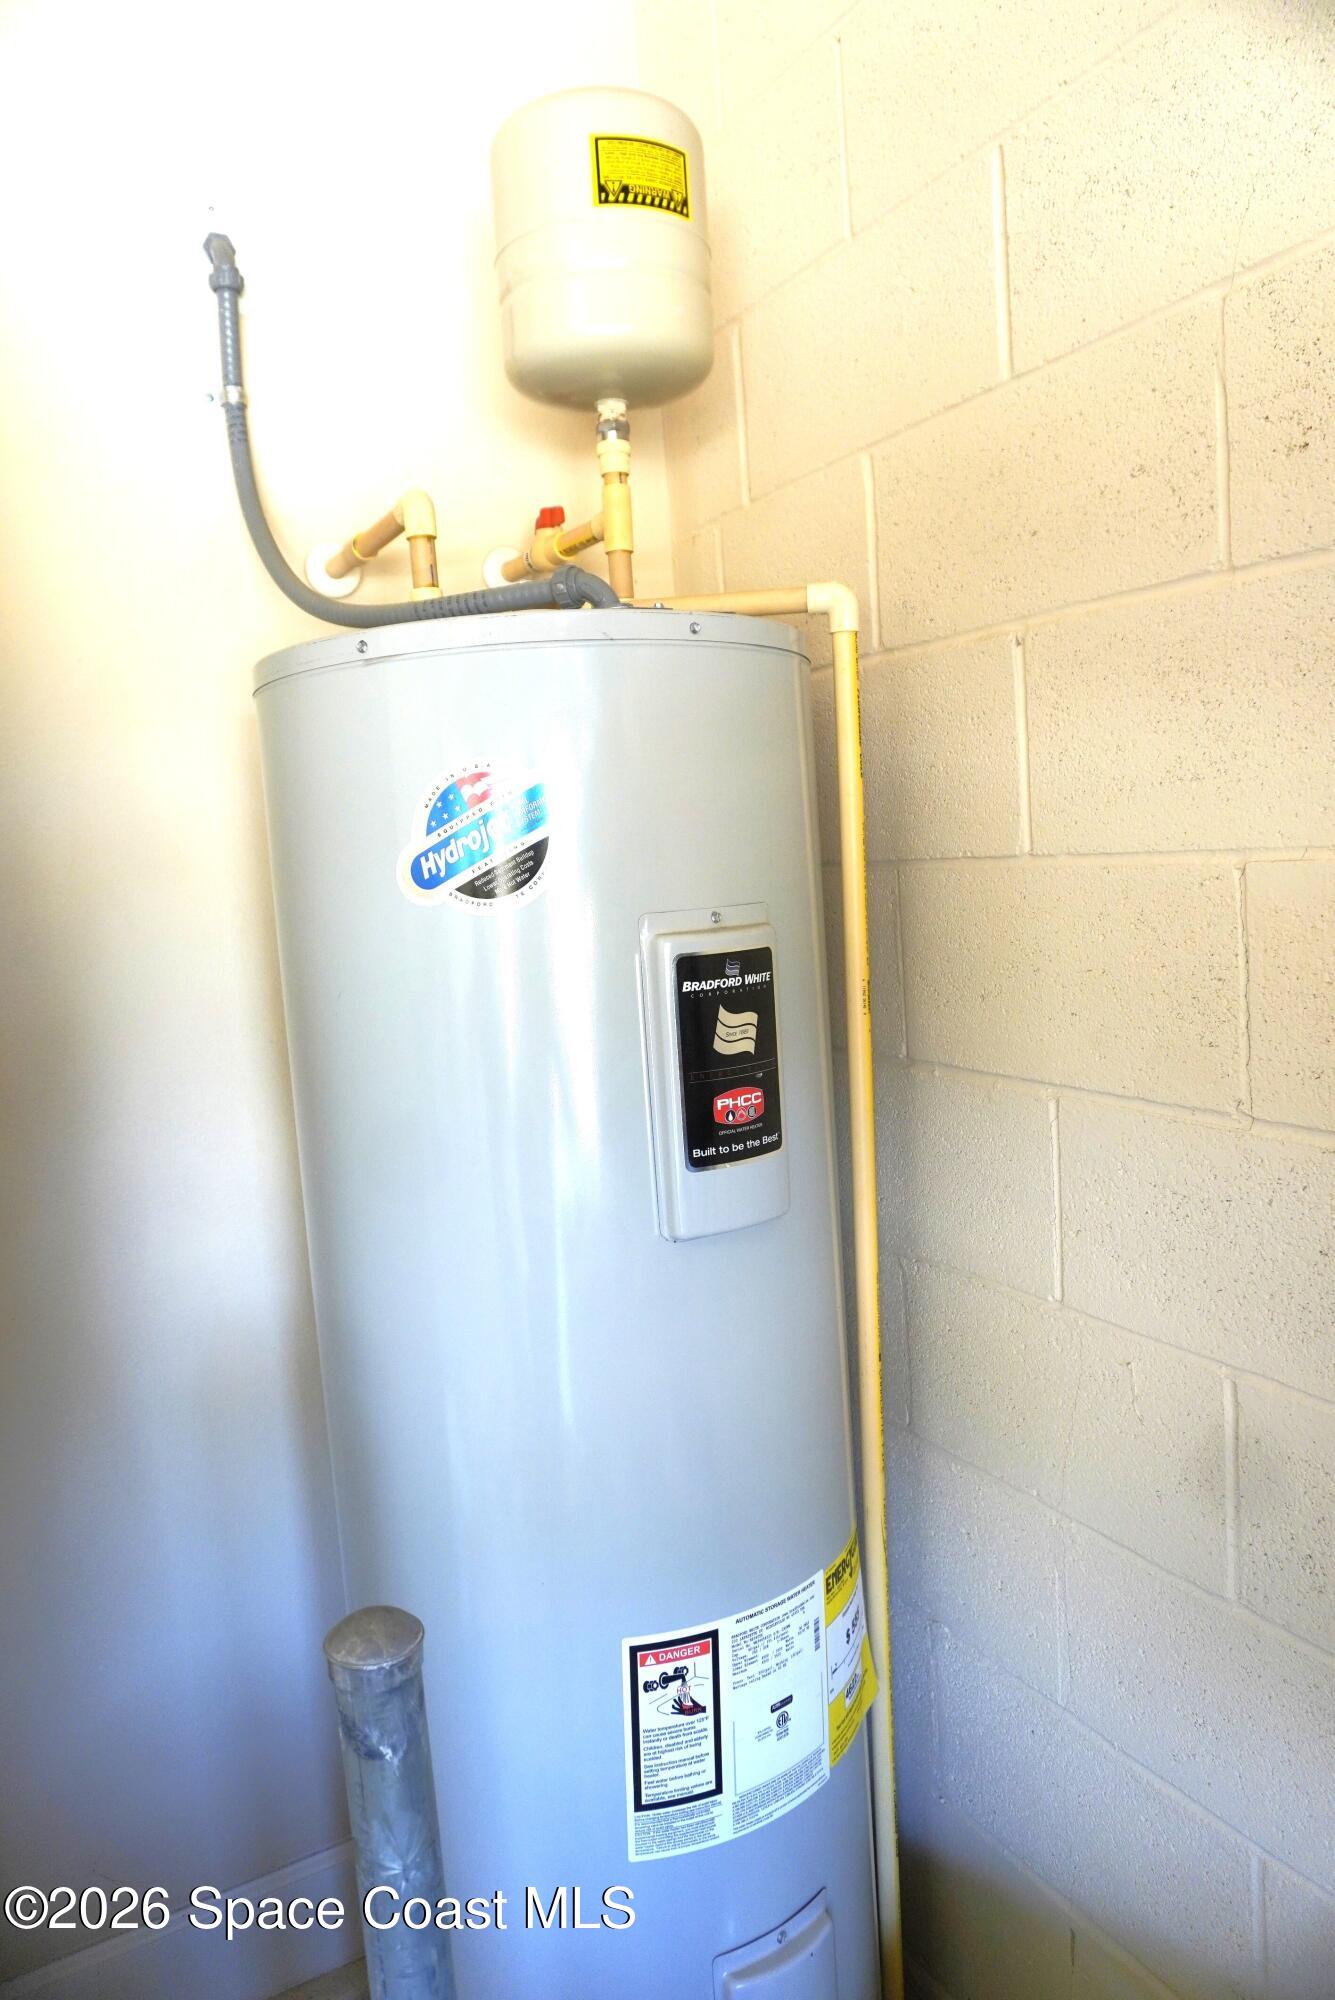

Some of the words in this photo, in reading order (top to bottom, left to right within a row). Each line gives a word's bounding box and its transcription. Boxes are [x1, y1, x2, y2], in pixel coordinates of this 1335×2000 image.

[629, 184, 671, 199] WARNING
[419, 808, 514, 881] Hydroj
[682, 976, 743, 993] BRADFORD
[744, 971, 772, 985] WHITE
[690, 984, 767, 999] CORPORATION
[716, 1092, 762, 1111] PHCC
[692, 1147, 717, 1158] Built
[718, 1146, 730, 1154] to
[731, 1143, 745, 1152] be
[746, 1138, 761, 1149] the
[762, 1132, 779, 1145] Best
[735, 1608, 765, 1625] AUTOMATIC
[764, 1598, 787, 1614] STORAGE
[786, 1589, 801, 1602] WATER
[800, 1580, 816, 1593] HEATER
[658, 1645, 701, 1662] DANGER
[677, 1685, 692, 1694] HOT
